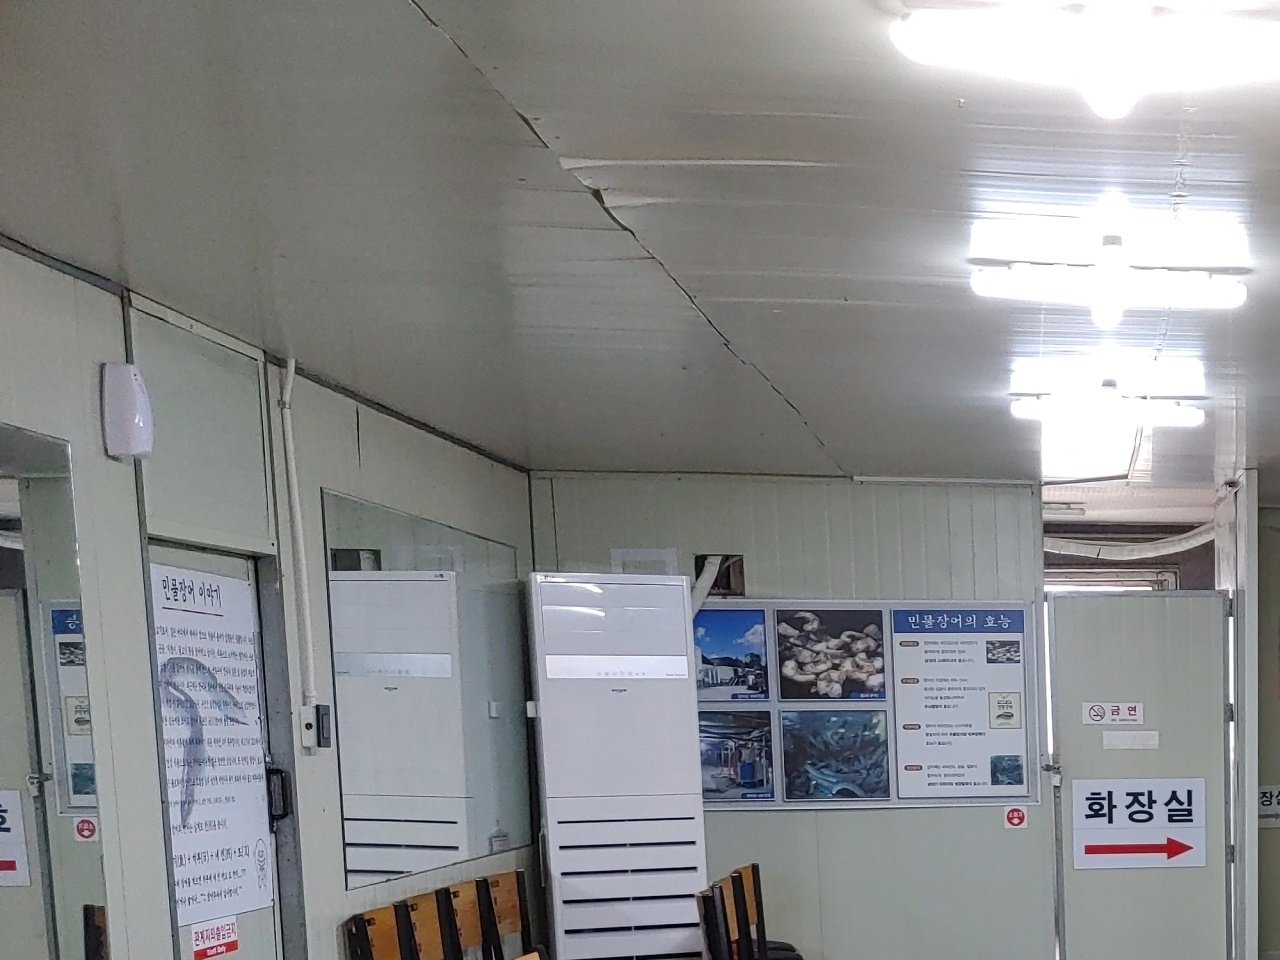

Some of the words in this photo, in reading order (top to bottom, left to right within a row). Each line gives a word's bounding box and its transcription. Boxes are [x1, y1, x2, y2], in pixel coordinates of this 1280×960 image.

[161, 575, 196, 606] 민물장어
[198, 581, 222, 608] 이야기
[907, 613, 977, 629] 민물장어의
[983, 614, 1012, 629] 효능
[1084, 788, 1194, 825] 화장실
[193, 922, 237, 947] 관계자외출입금지
